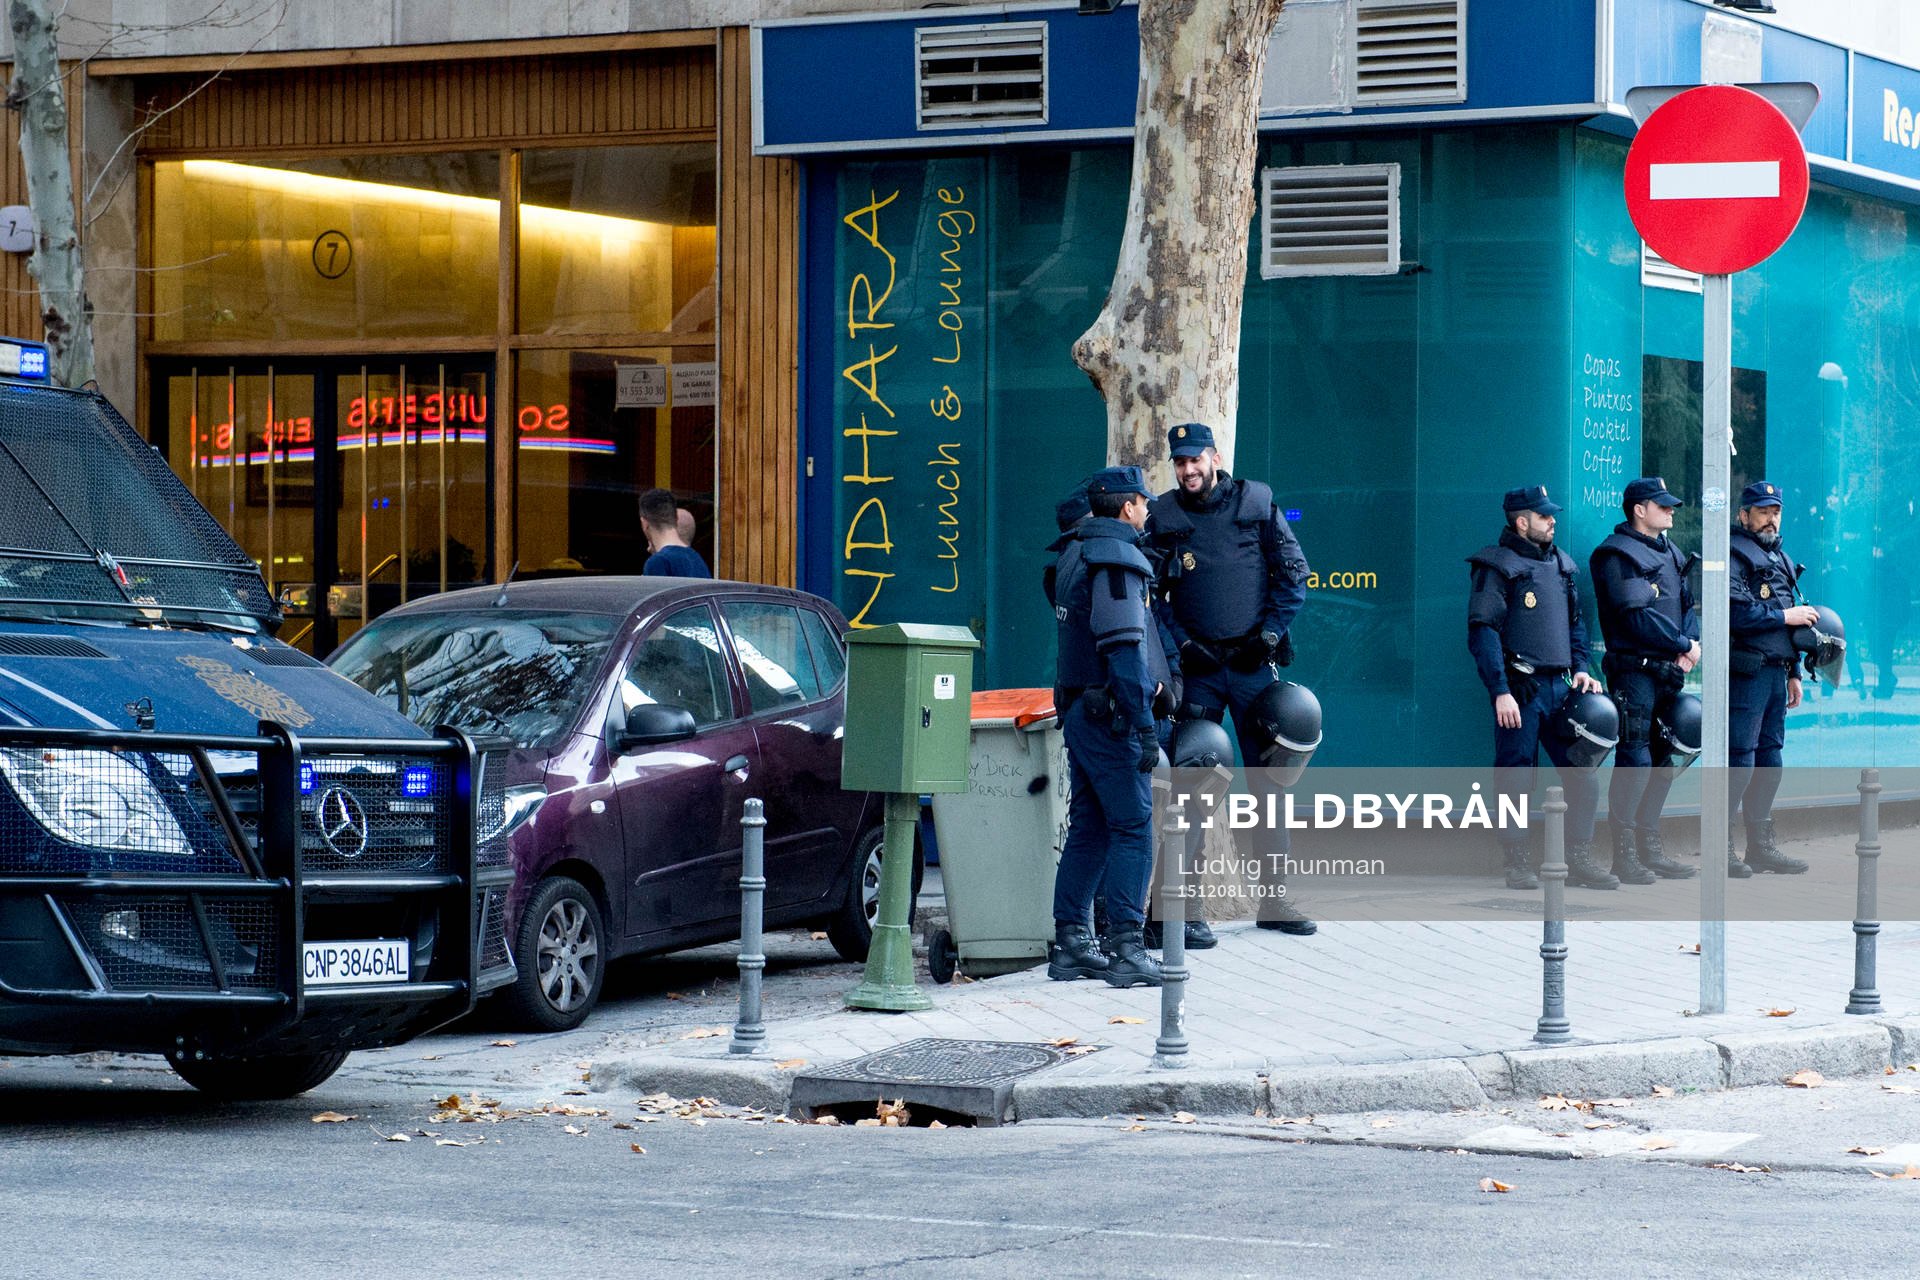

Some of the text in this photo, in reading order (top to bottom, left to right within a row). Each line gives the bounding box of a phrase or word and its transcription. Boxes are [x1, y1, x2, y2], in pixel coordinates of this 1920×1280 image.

[9, 220, 17, 237] 7
[327, 242, 338, 273] 7
[1583, 353, 1622, 386] Copas
[928, 187, 976, 592] Lunch & Lounge
[1583, 384, 1633, 412] Pintxos
[1583, 417, 1631, 442] Cocktel
[1583, 445, 1623, 480] Coffee
[1306, 571, 1377, 589] a.com
